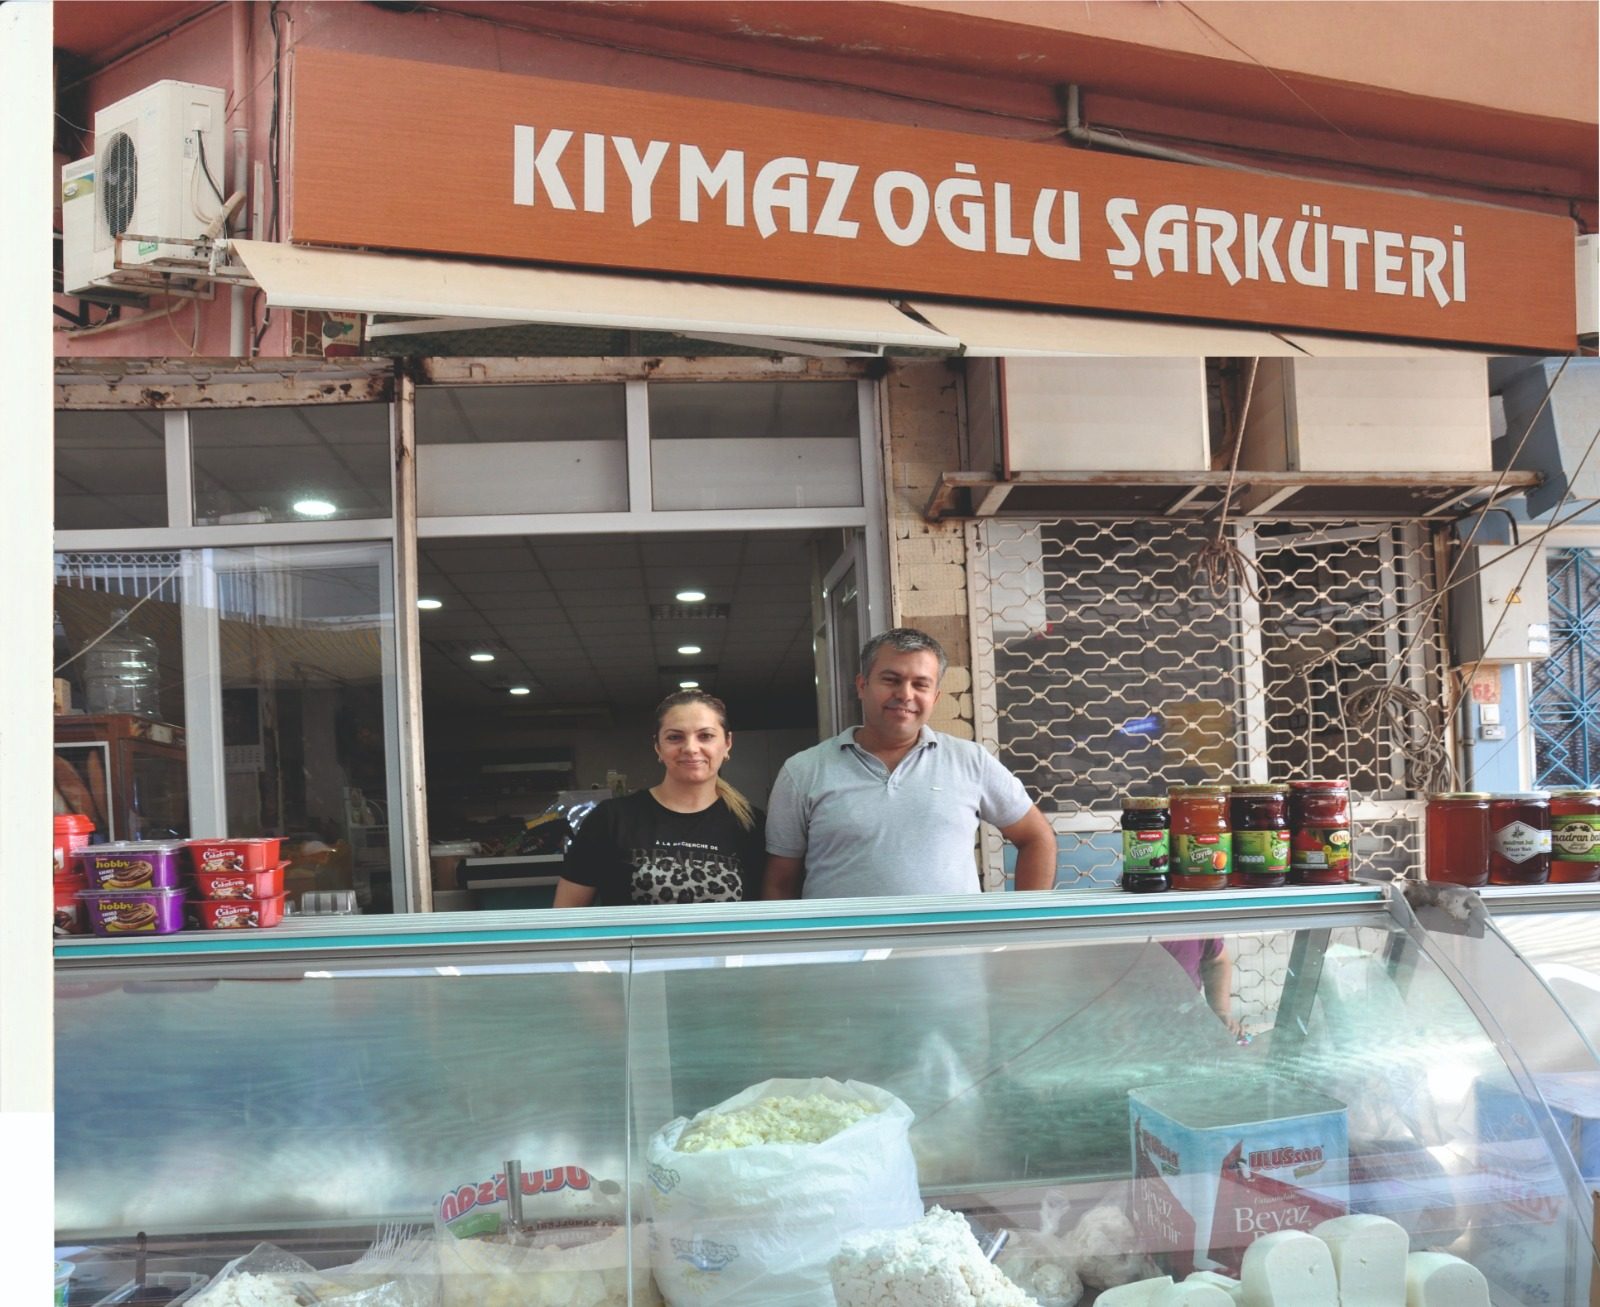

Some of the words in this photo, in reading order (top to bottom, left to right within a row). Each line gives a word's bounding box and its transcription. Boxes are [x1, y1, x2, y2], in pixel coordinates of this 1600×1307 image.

[1105, 197, 1466, 308] ŞARKÜTERİ
[95, 860, 129, 870] hobby
[99, 902, 134, 912] hobby
[1234, 1204, 1312, 1233] Beyaz
